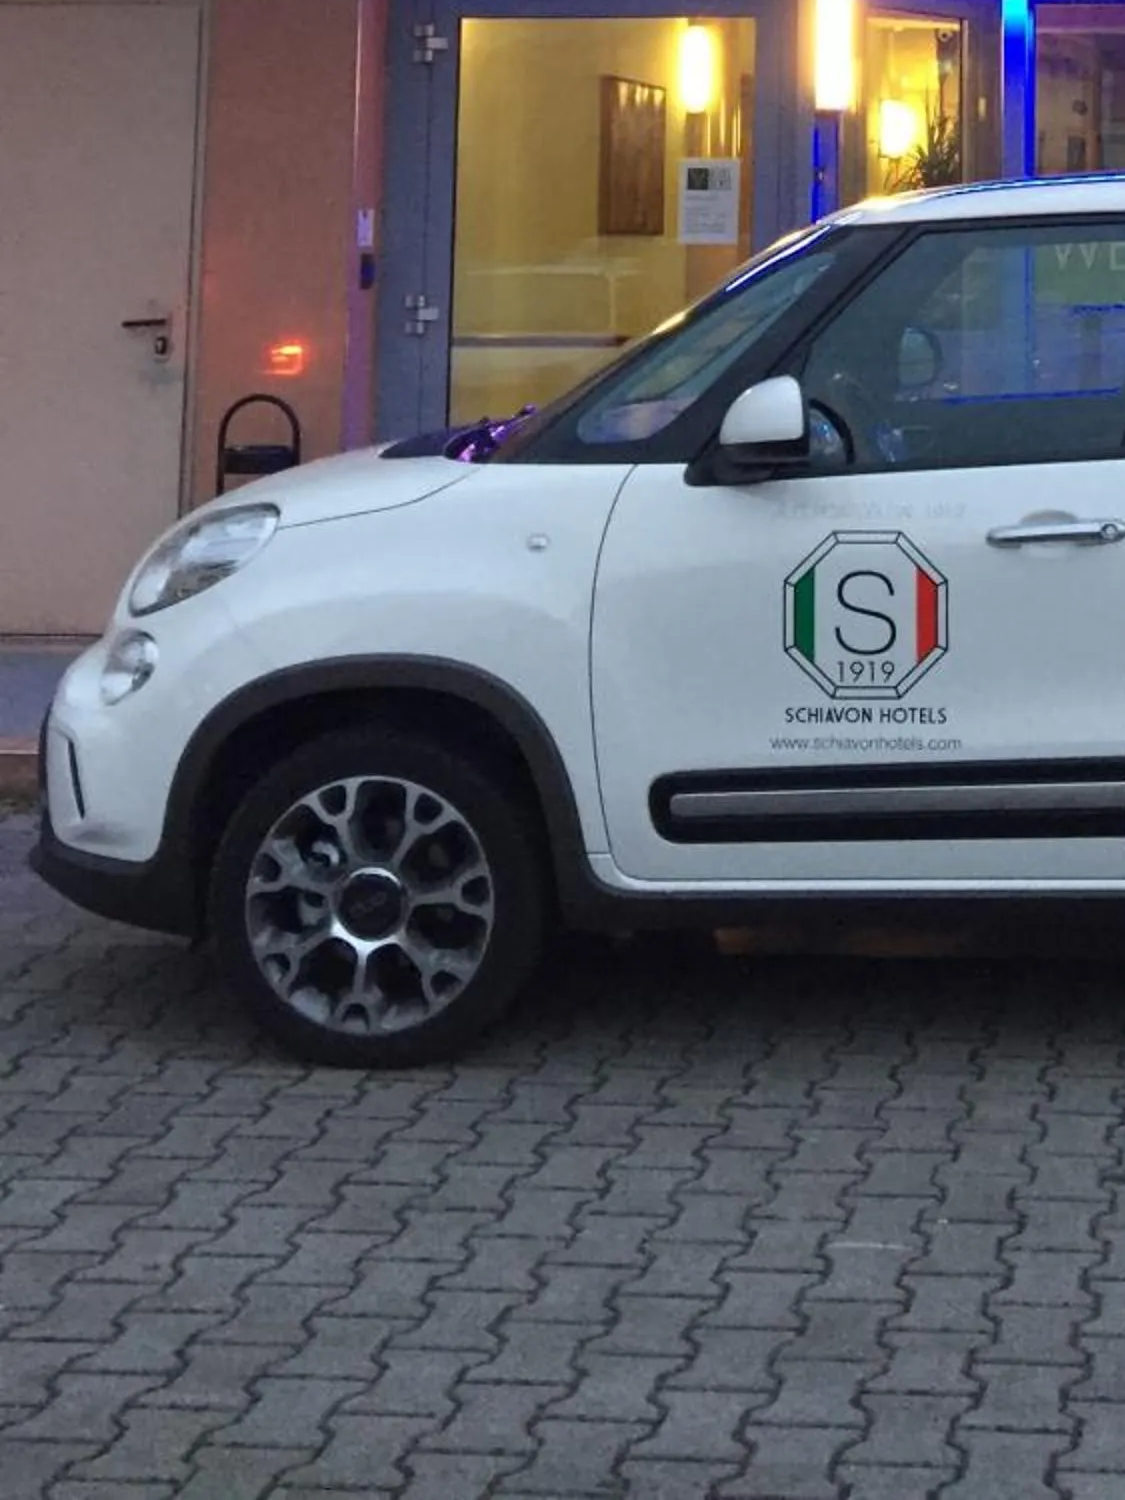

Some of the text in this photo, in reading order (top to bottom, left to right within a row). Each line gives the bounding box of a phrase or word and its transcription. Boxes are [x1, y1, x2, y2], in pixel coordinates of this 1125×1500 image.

[834, 570, 897, 656] S
[837, 661, 895, 683] 1919
[784, 707, 947, 724] SCHIAVON HOTELS
